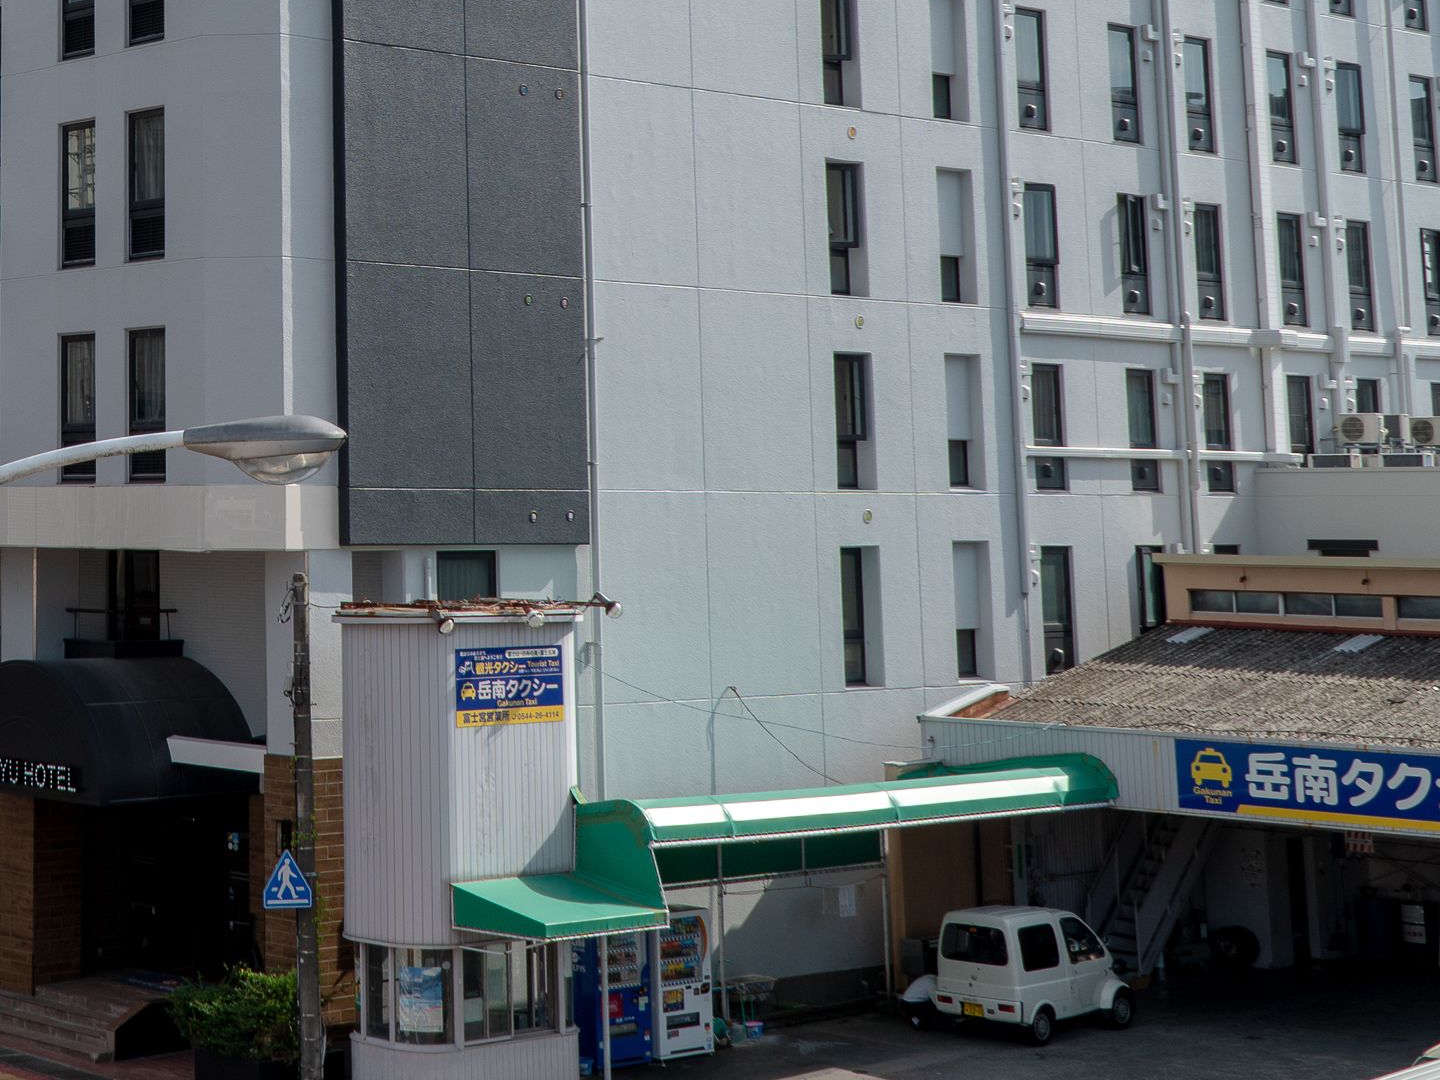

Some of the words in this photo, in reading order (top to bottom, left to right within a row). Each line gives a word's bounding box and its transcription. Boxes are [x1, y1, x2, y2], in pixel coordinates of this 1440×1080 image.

[475, 661, 526, 675] 観光タクシー
[528, 660, 547, 668] Tourist
[548, 659, 560, 667] Taxi
[477, 678, 559, 700] 岳南タクシー
[497, 699, 525, 707] Gakunan
[525, 697, 538, 706] Taxi
[463, 710, 510, 724] 富士宮営業所
[24, 761, 76, 792] HOTEL
[1245, 752, 1440, 810] 岳南タク
[1193, 786, 1232, 797] Gakunan
[1205, 796, 1222, 805] Taxi
